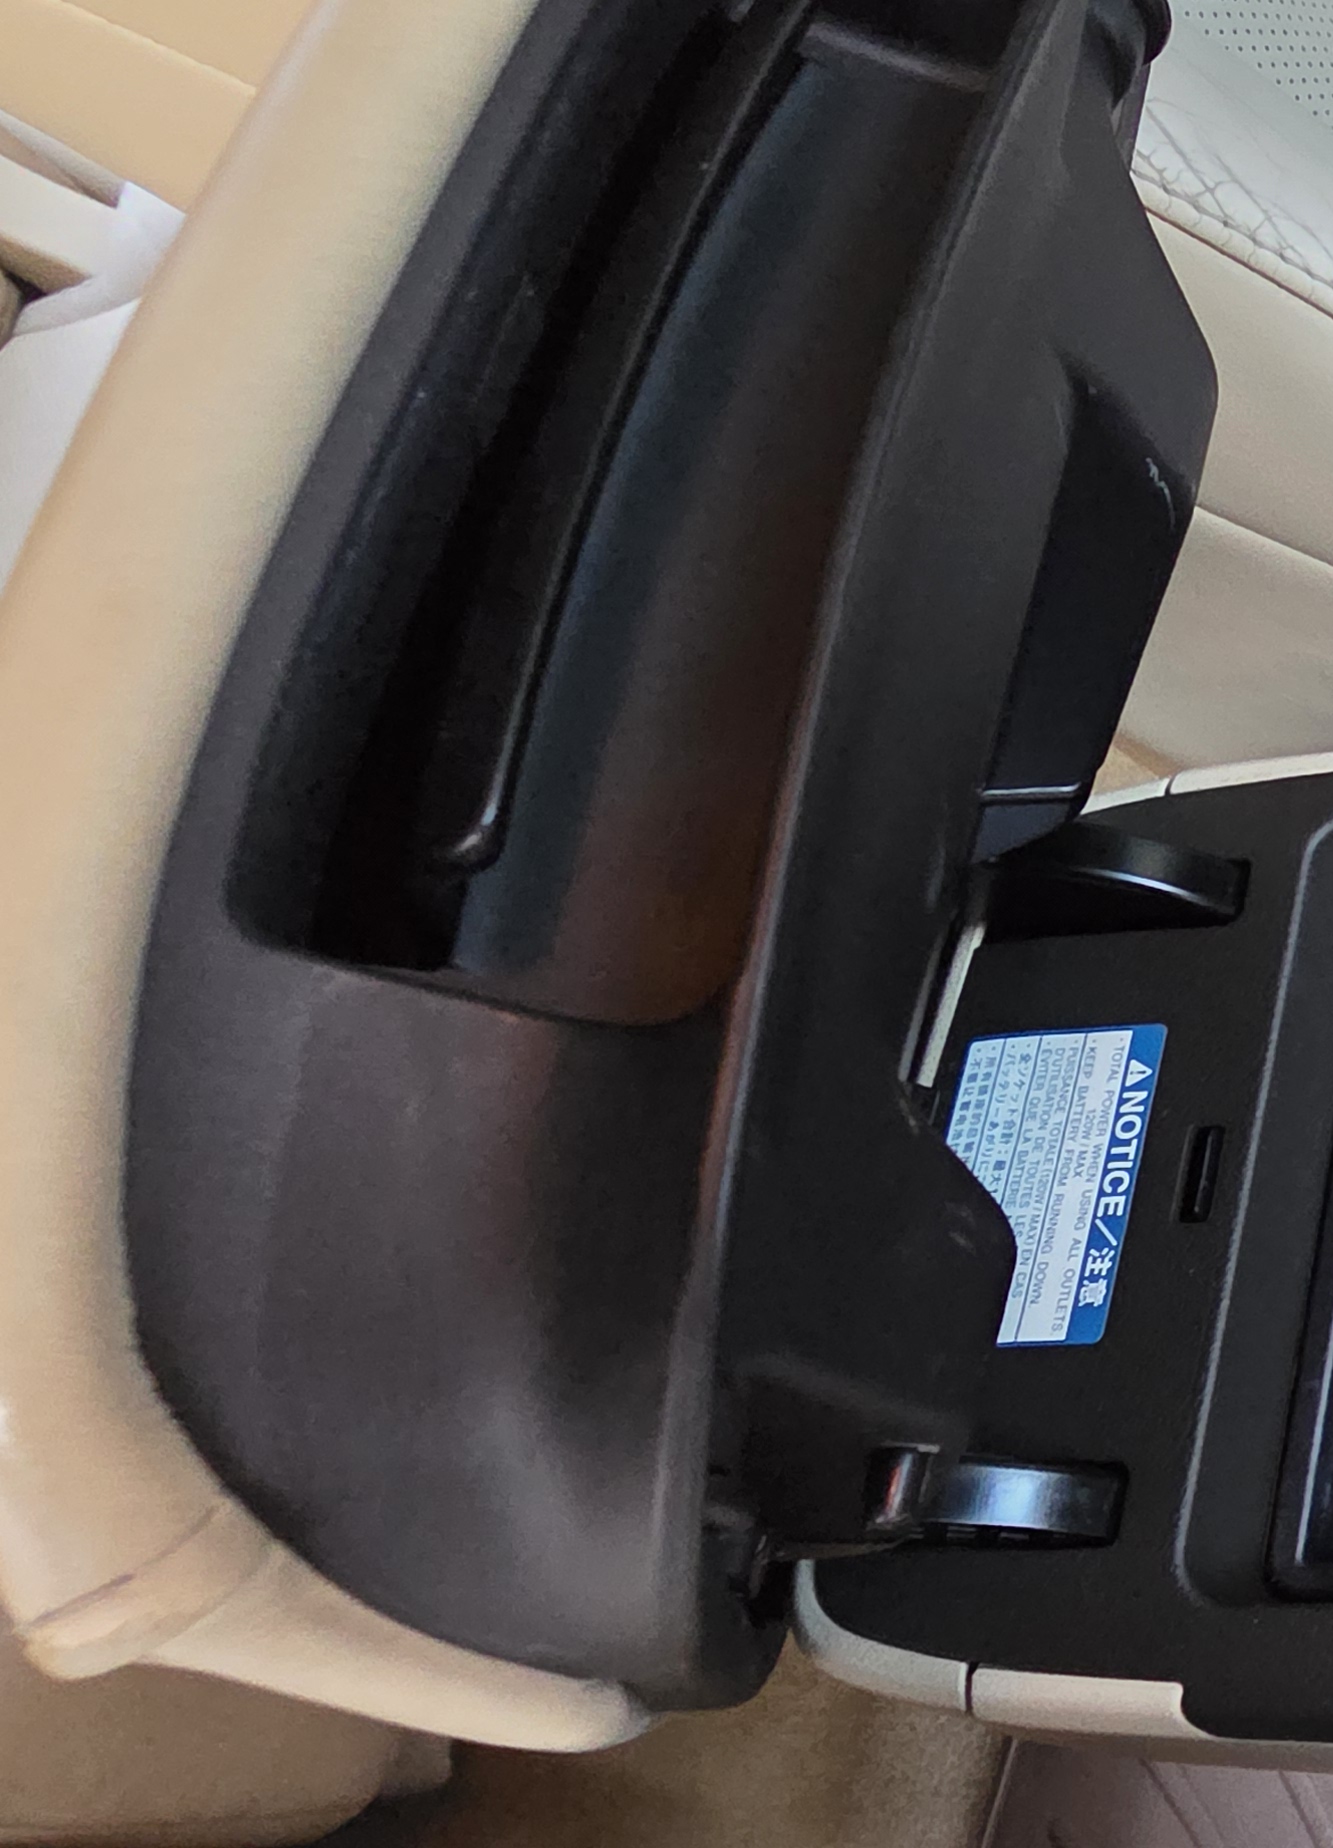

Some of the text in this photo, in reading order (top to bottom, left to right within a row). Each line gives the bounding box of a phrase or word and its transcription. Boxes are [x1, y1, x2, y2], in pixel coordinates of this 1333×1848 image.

[1053, 1046, 1079, 1114] PUISSANCE
[1082, 1046, 1097, 1079] KEEP
[1105, 1045, 1125, 1083] TOTAL
[1025, 1096, 1041, 1122] QUE
[1066, 1085, 1089, 1142] BATTERY
[1094, 1089, 1115, 1137] POWER
[1011, 1047, 1065, 1239] D'UTILISATION DE TOUTES LES
[1021, 1127, 1033, 1144] LA
[1042, 1120, 1063, 1165] TOTALE
[1004, 1149, 1029, 1208] BATTERIE
[1056, 1148, 1074, 1187] FROM
[1071, 1149, 1088, 1178] MAX
[1084, 1142, 1103, 1183] WHEN
[1040, 1193, 1064, 1254] RUNNING
[1073, 1188, 1093, 1231] USING
[1018, 1248, 1033, 1266] EN
[1066, 1237, 1082, 1261] ALL
[1010, 1271, 1027, 1298] CAS
